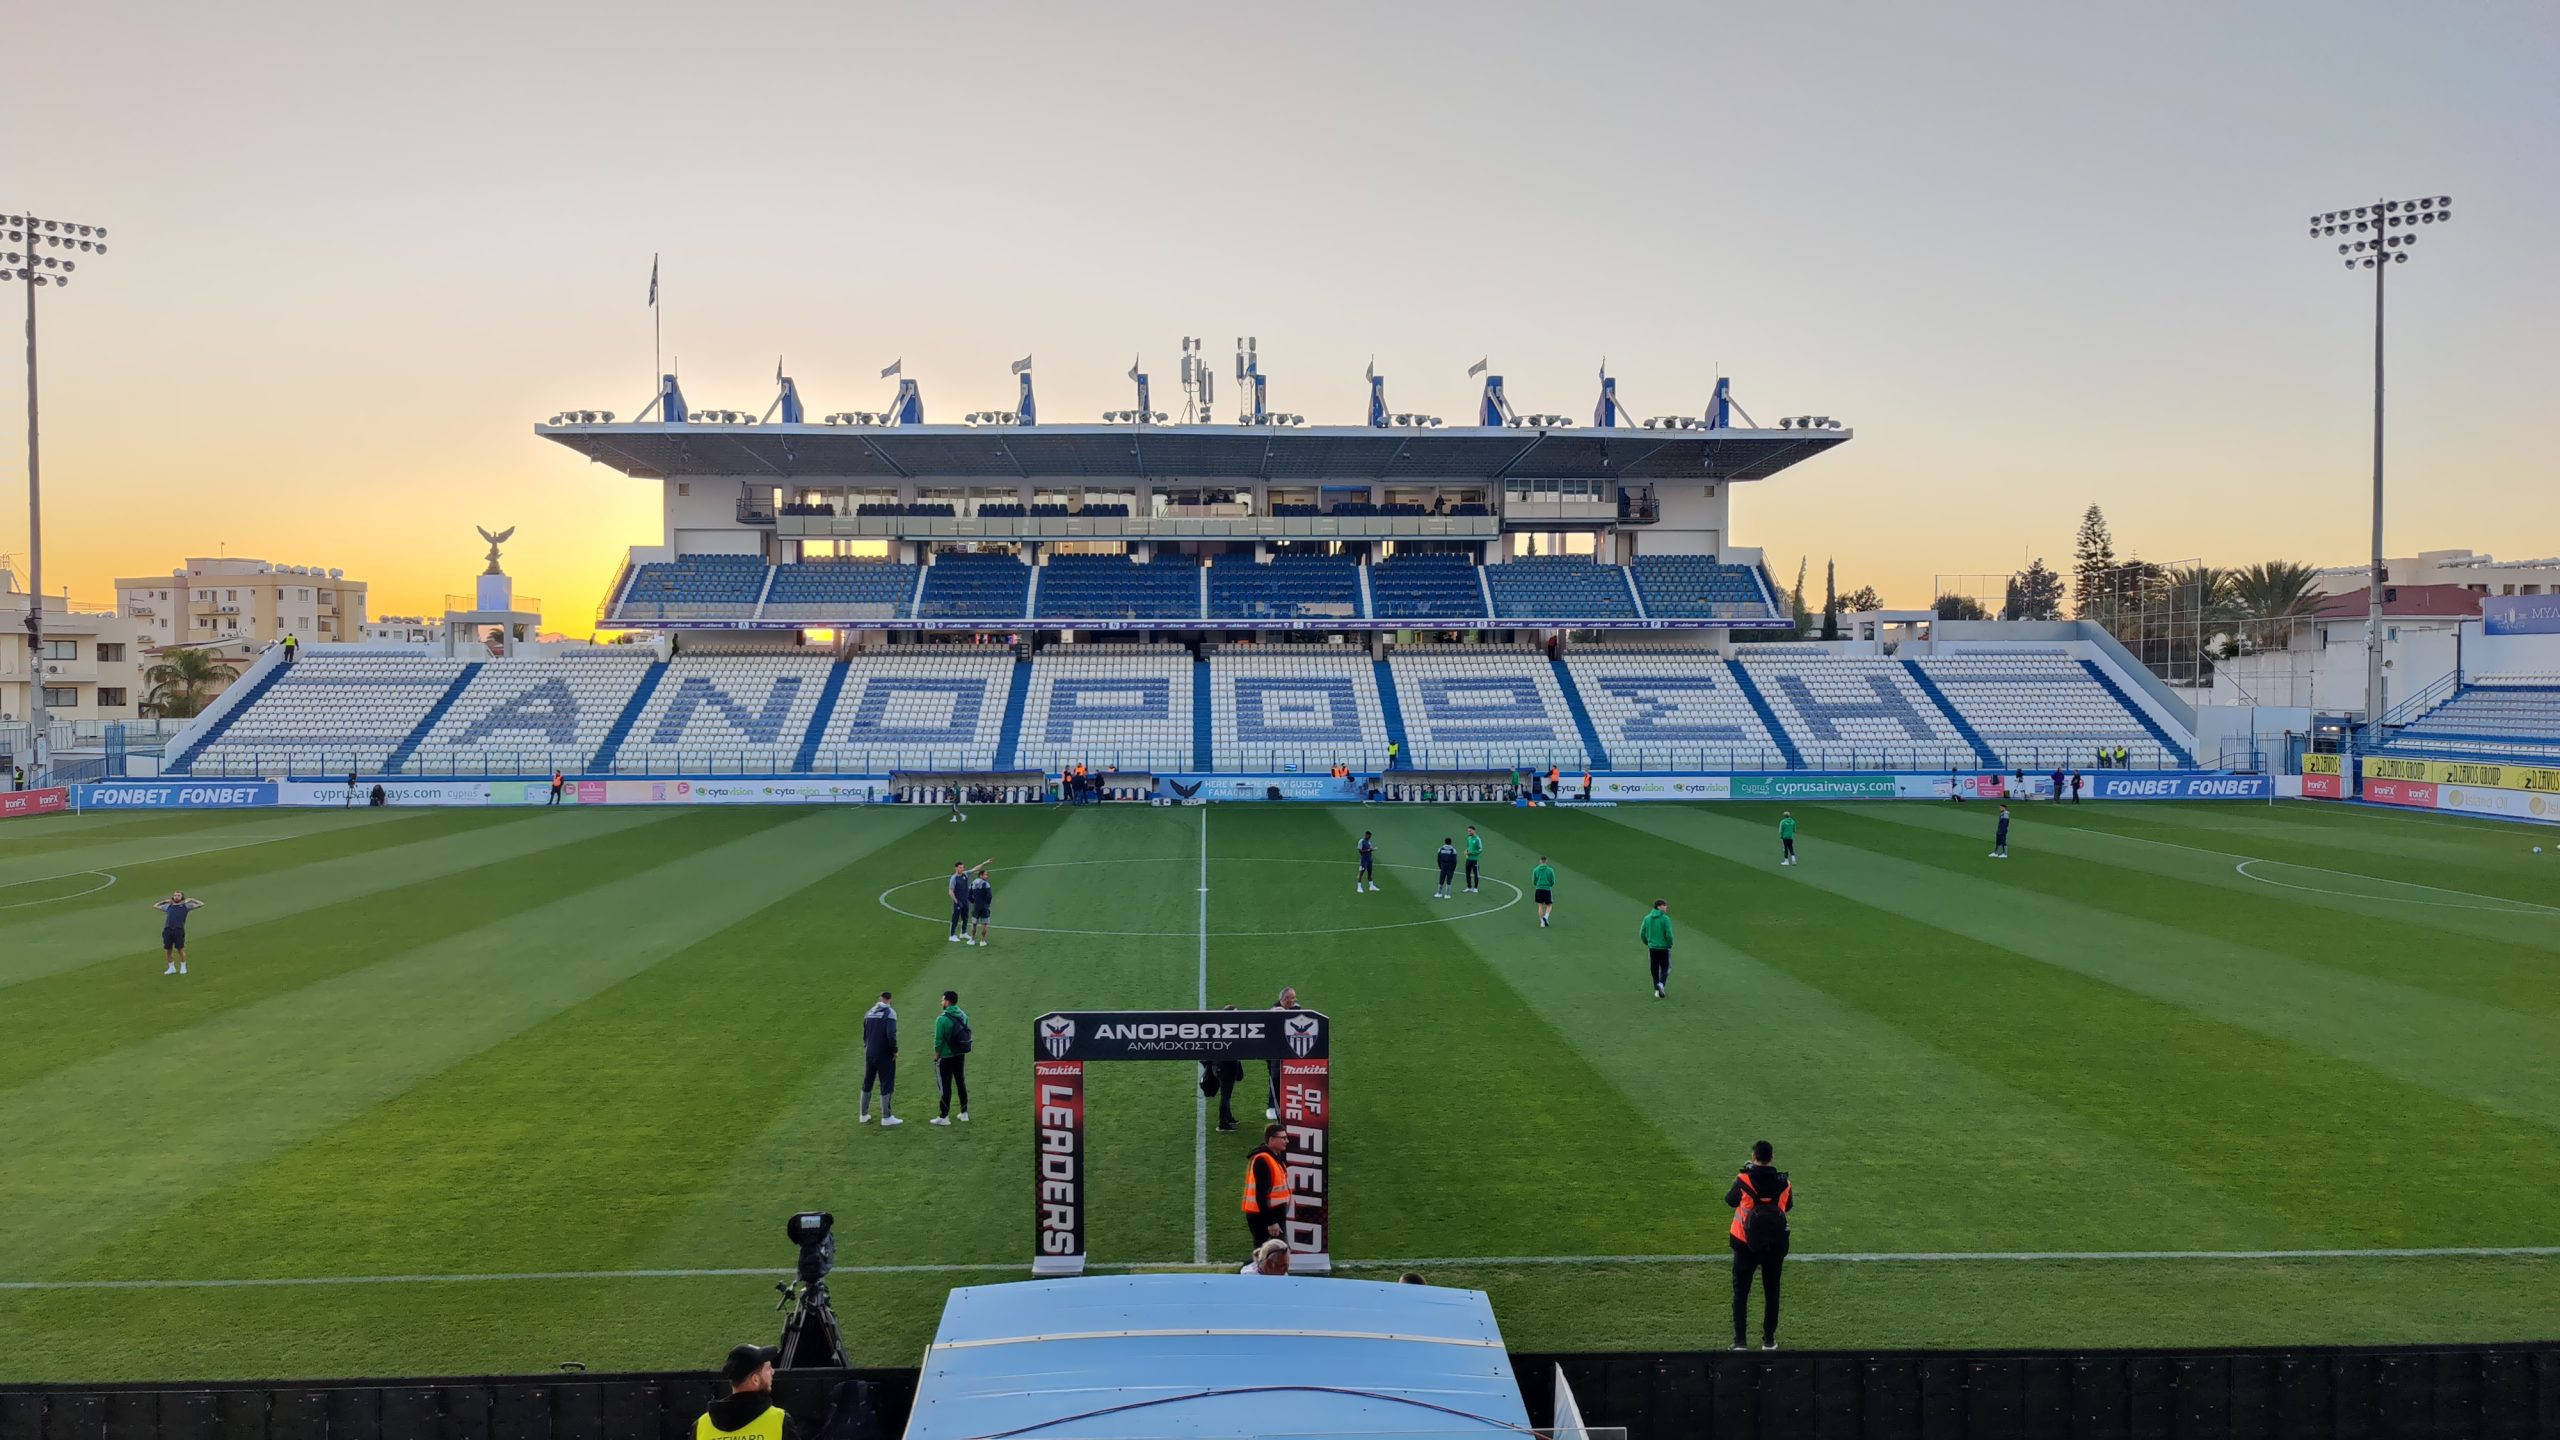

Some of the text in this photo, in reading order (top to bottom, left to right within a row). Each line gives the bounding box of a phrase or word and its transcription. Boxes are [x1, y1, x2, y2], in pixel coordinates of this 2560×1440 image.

[313, 786, 442, 801] cyprusaiays.com
[1296, 789, 1320, 797] HOME
[1775, 778, 1895, 794] cyprusairways.com
[2106, 780, 2262, 795] FONBET FONBET
[91, 788, 258, 804] FONBET FONBET
[1094, 1023, 1265, 1040] ΑΝΟΡΘΩΣΙΣ
[1127, 1041, 1232, 1051] ΑΜΜΟΧΩΣΤΟΥ
[1286, 1083, 1302, 1121] THE
[1304, 1088, 1321, 1115] OF
[1041, 1083, 1075, 1255] LEADERS
[1286, 1125, 1323, 1254] FIELD
